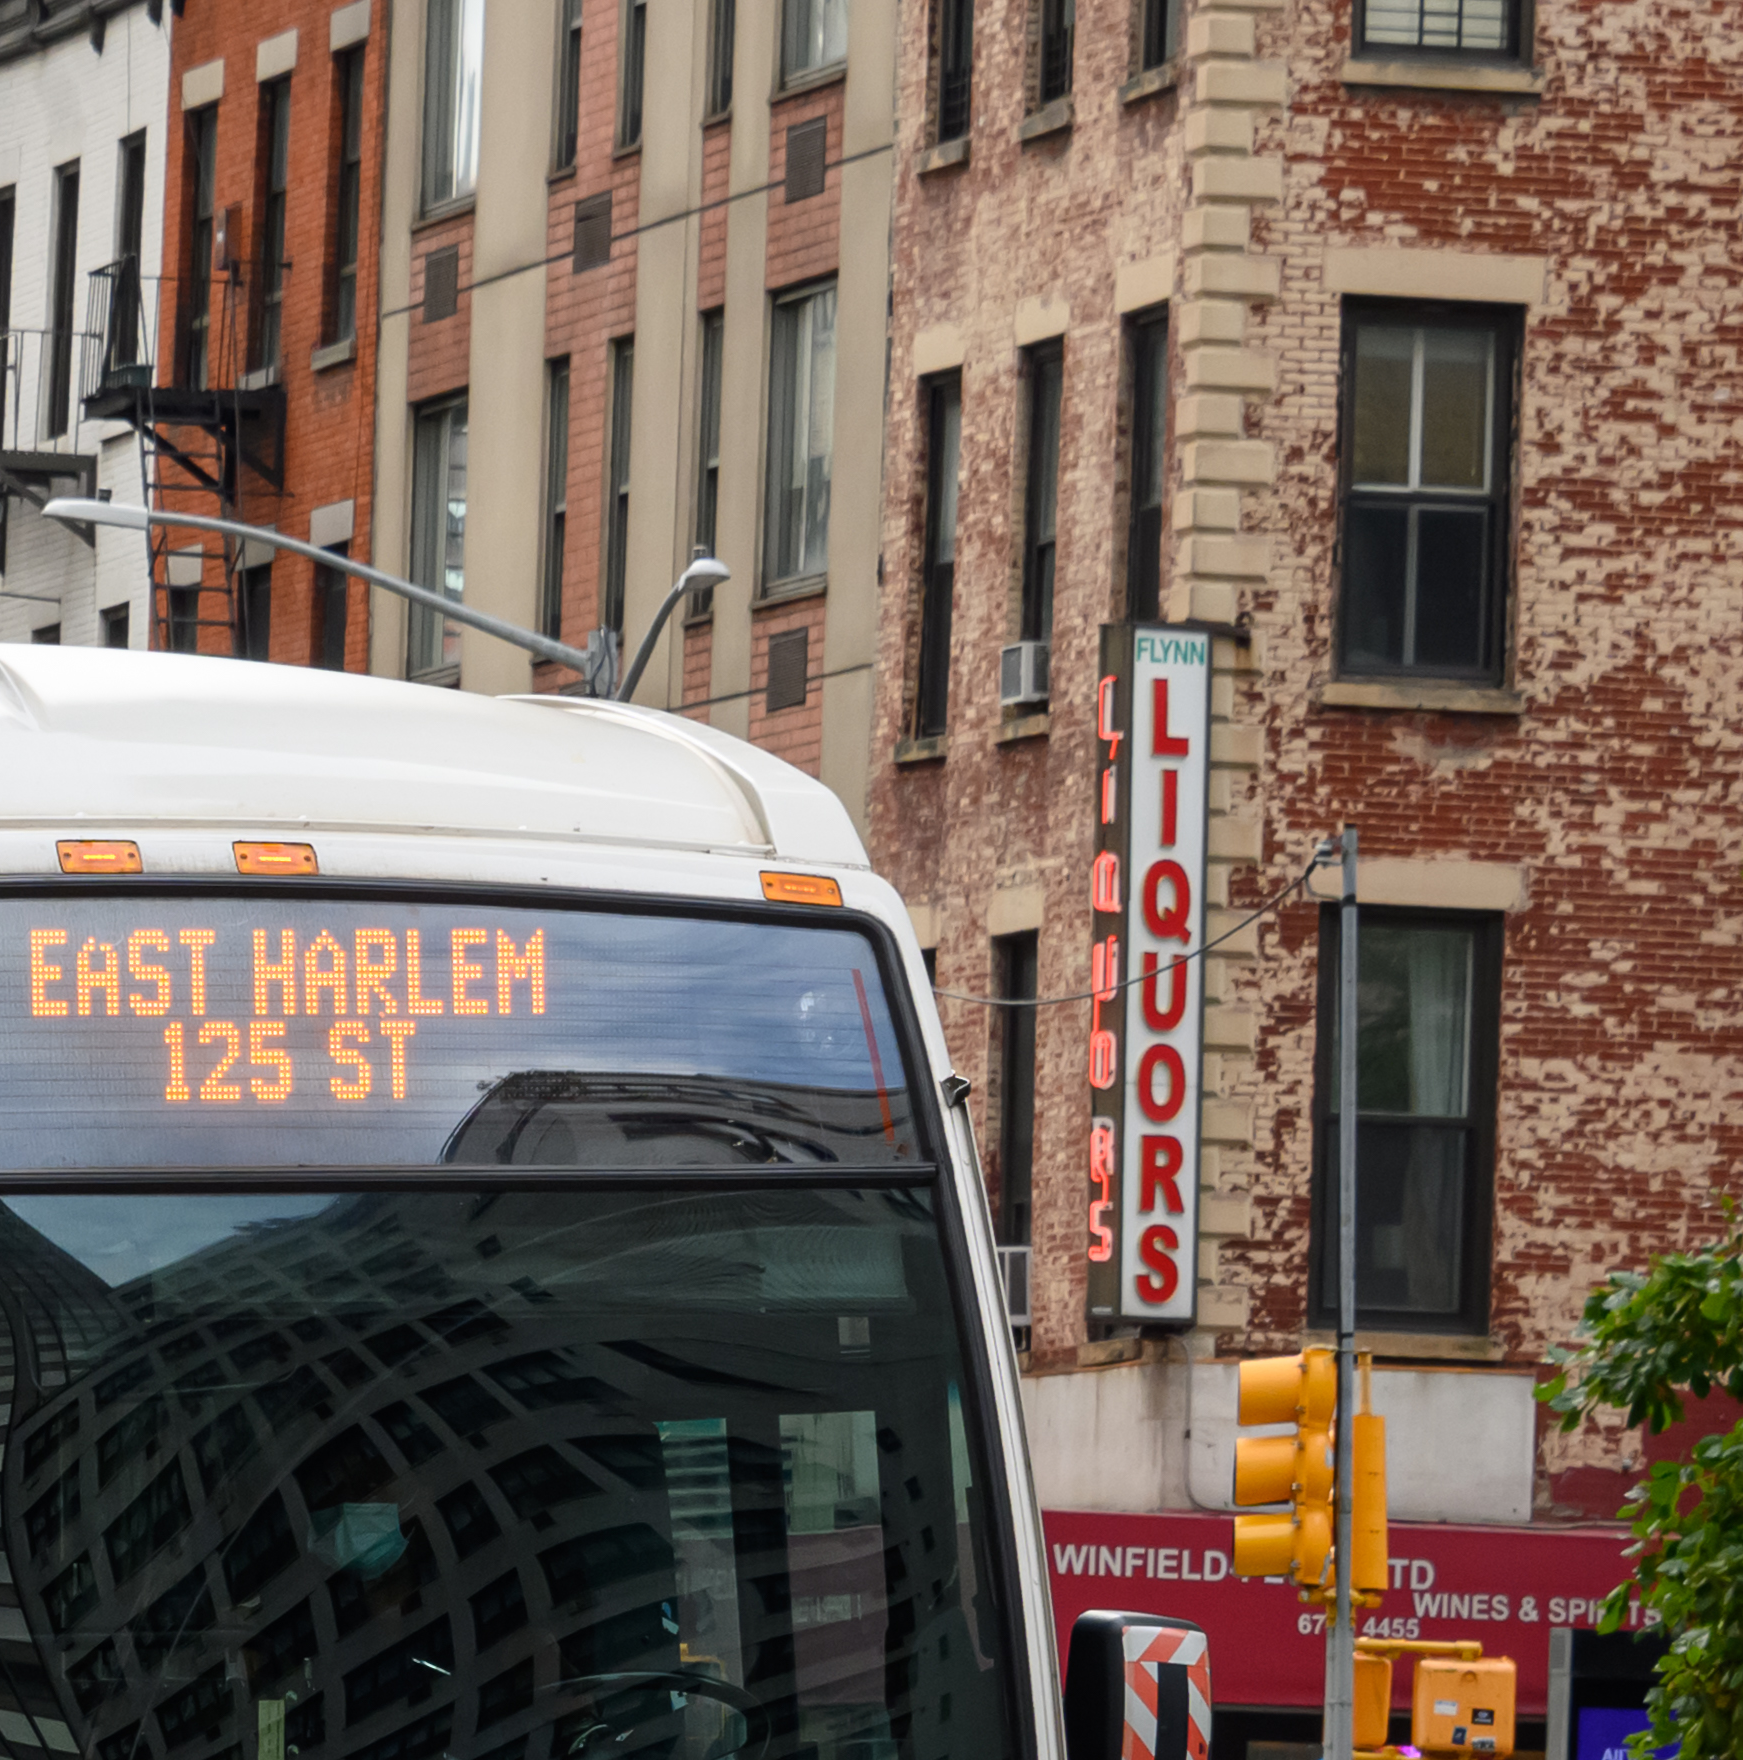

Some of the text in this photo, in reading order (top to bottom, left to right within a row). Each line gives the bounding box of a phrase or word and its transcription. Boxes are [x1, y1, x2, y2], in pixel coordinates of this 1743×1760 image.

[1136, 637, 1206, 666] FLYNN
[29, 928, 546, 1016] EAST HARLEM
[1135, 678, 1193, 1305] LIQUORS
[162, 1020, 417, 1101] 125 ST
[1387, 1558, 1435, 1590] TD
[1414, 1592, 1663, 1625] WINES & SPITS
